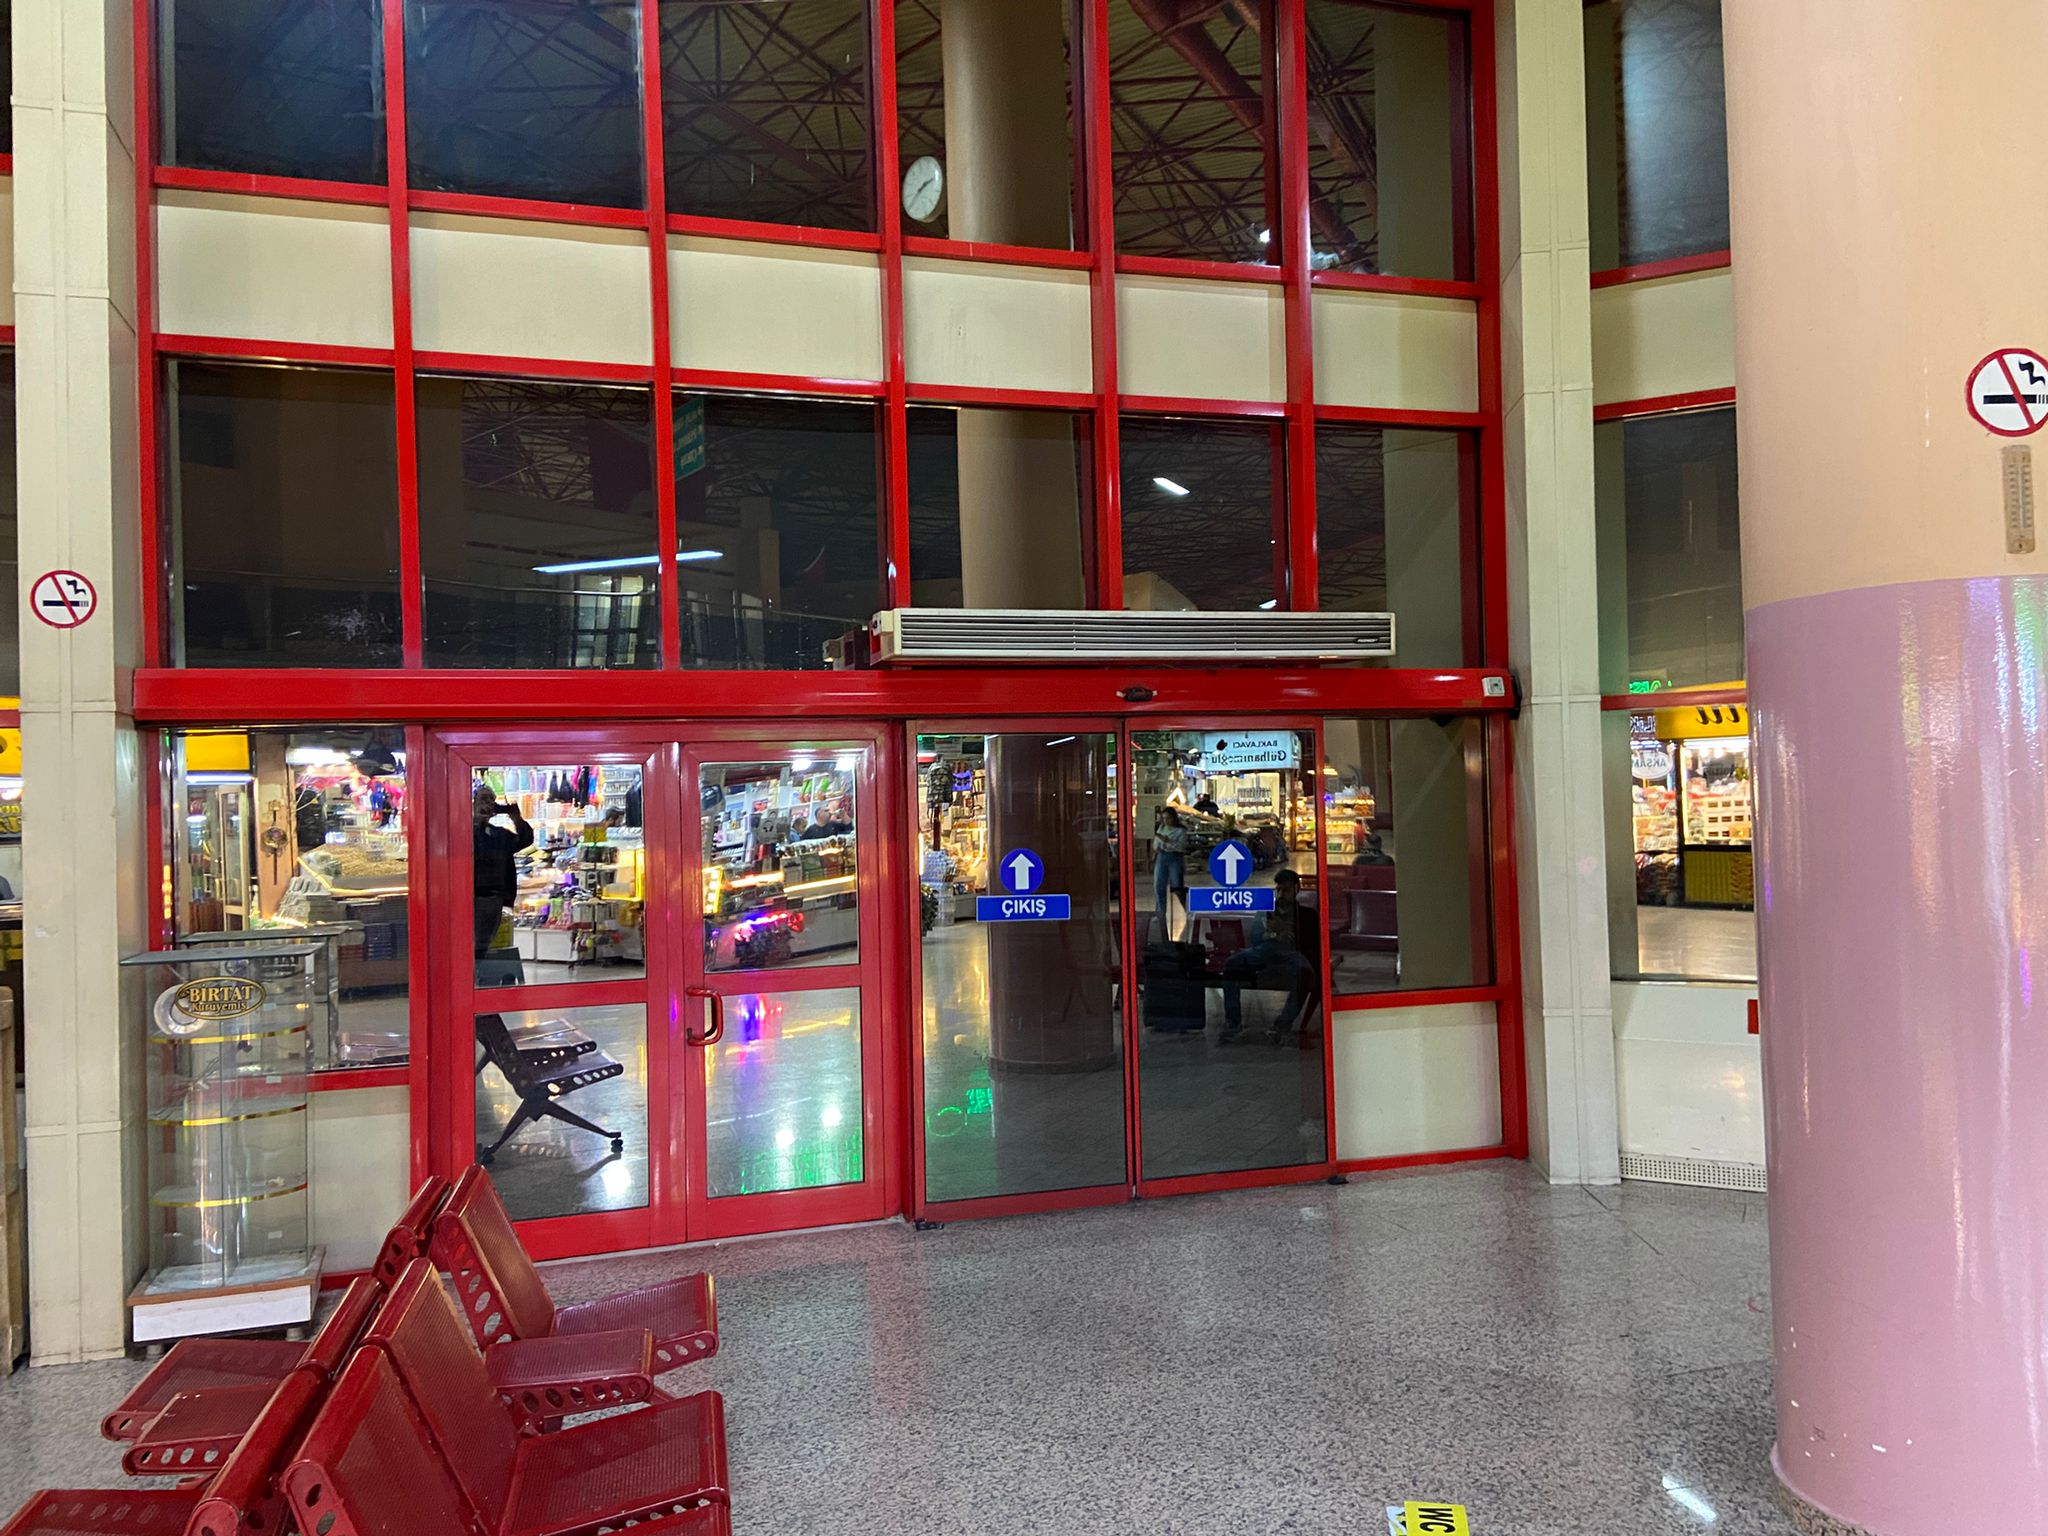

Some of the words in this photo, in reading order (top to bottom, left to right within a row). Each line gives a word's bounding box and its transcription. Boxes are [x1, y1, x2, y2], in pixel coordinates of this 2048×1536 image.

[1001, 899, 1047, 918] ÇIKIŞ
[1211, 890, 1254, 908] ÇIKIŞ
[189, 983, 254, 1003] BİRTAT
[1418, 1507, 1456, 1533] WC
